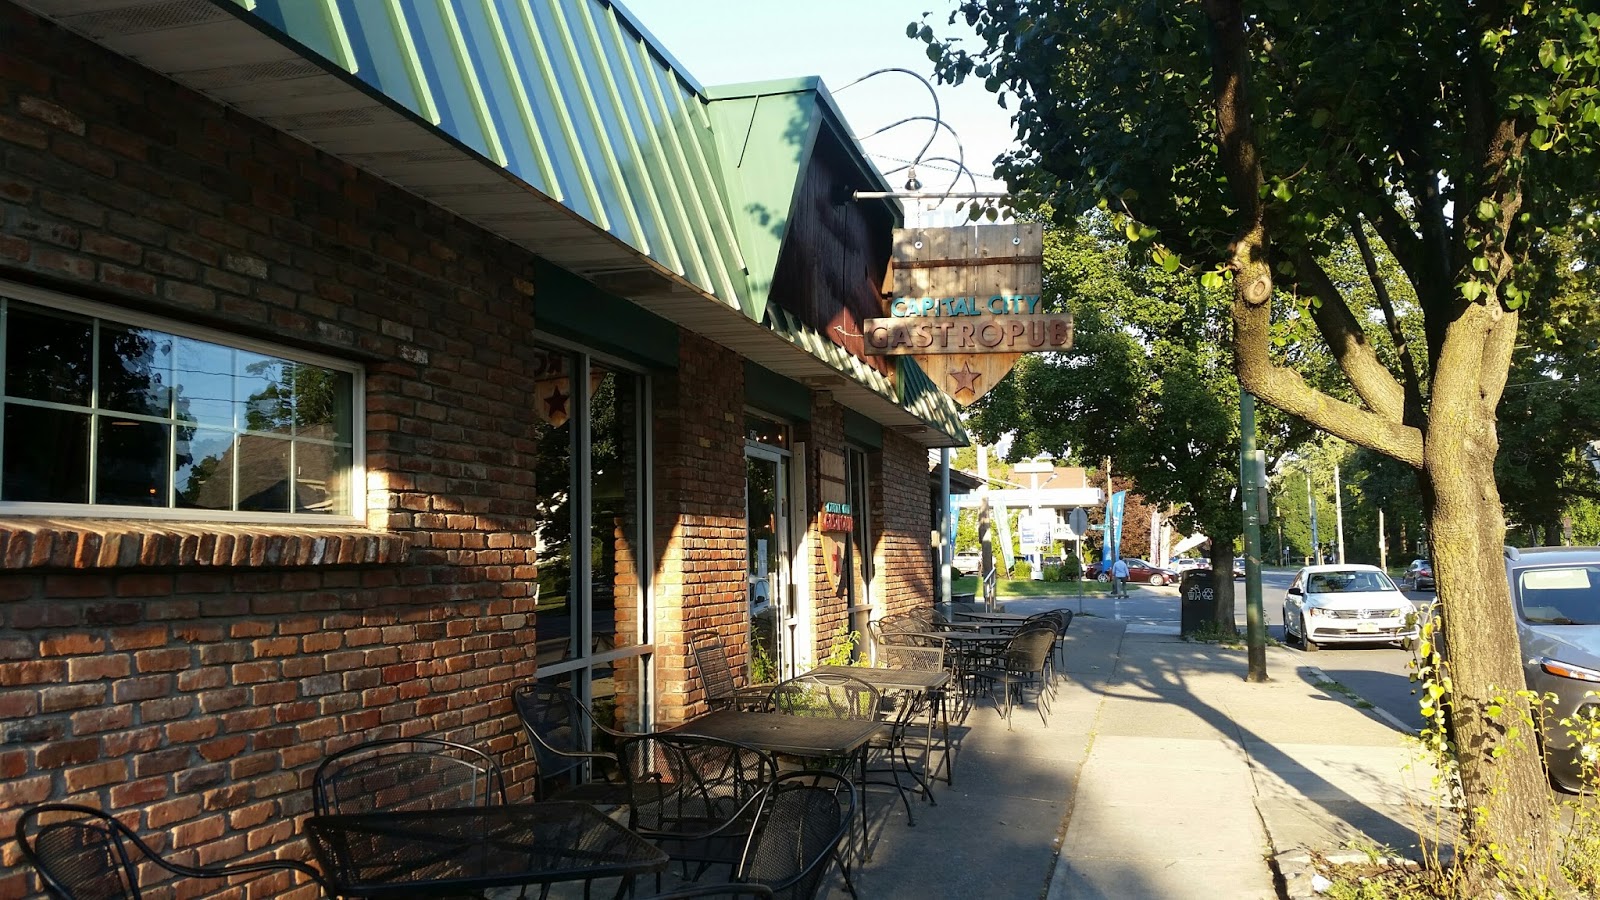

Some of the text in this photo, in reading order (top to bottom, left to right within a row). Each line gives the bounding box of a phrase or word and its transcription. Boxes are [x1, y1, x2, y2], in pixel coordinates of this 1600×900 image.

[890, 295, 1041, 317] CAPITAL CITY
[868, 320, 1068, 348] GASTROPUB
